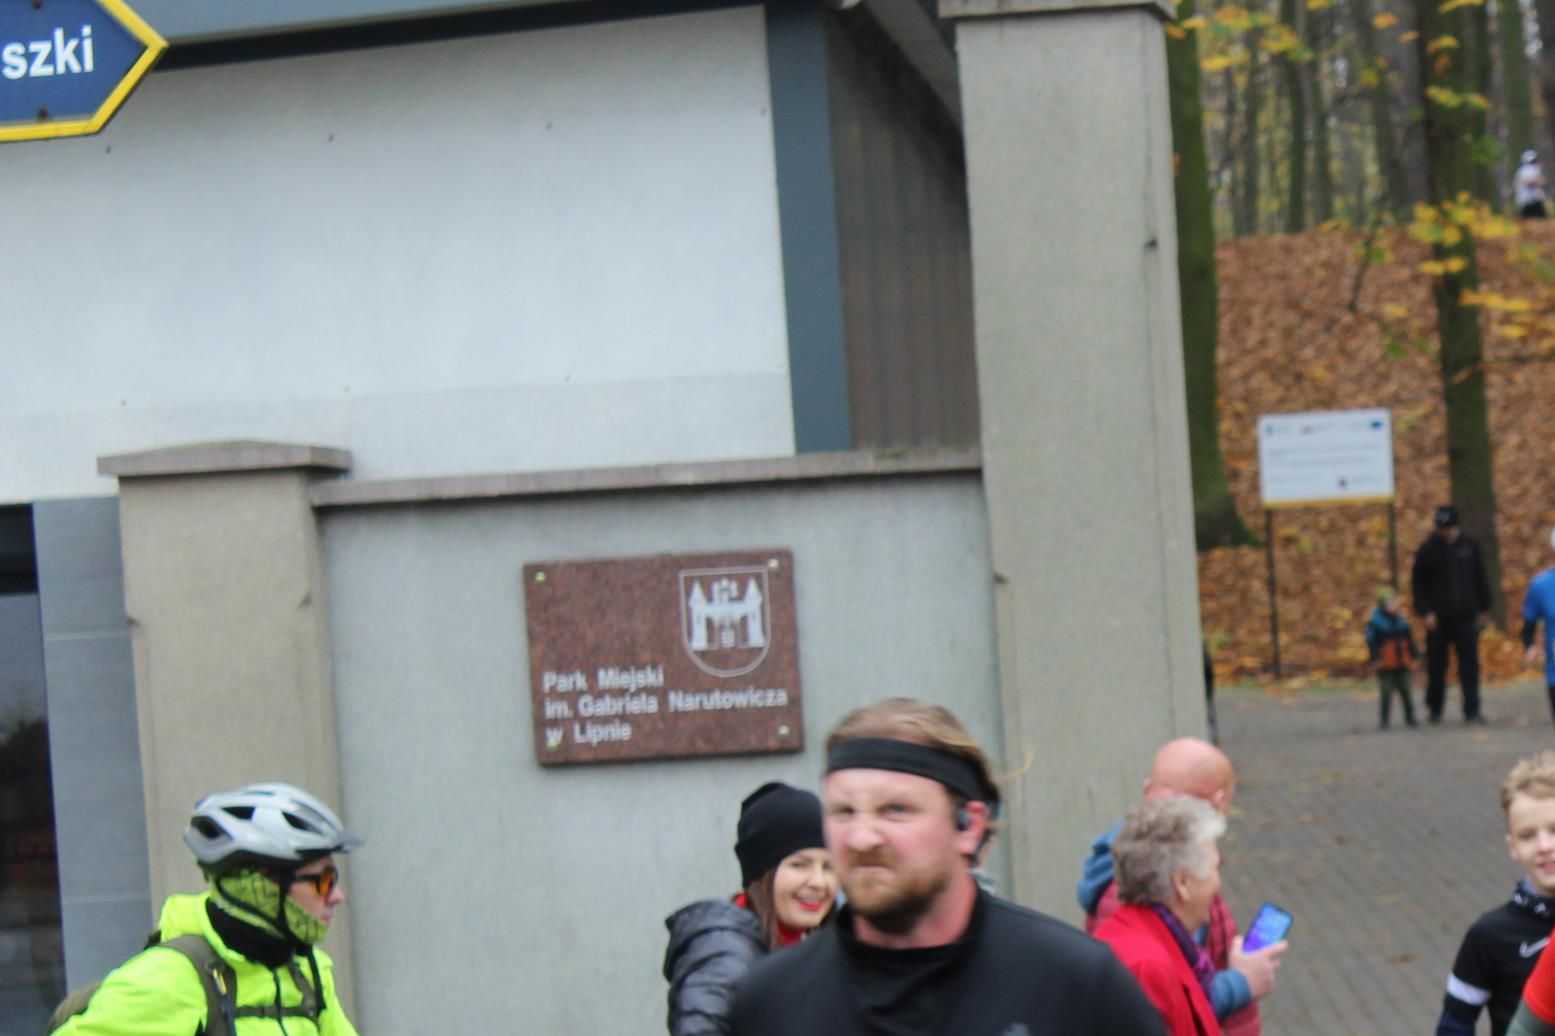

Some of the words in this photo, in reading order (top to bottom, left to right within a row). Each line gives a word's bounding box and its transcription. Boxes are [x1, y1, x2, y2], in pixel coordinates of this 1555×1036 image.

[2, 25, 94, 79] szki
[542, 669, 588, 693] Park
[597, 665, 664, 692] Miejski
[544, 698, 573, 719] im.
[577, 692, 659, 717] Gabriela
[667, 687, 788, 711] Narutowicza
[545, 726, 563, 744] w
[573, 720, 632, 746] Lipnie
